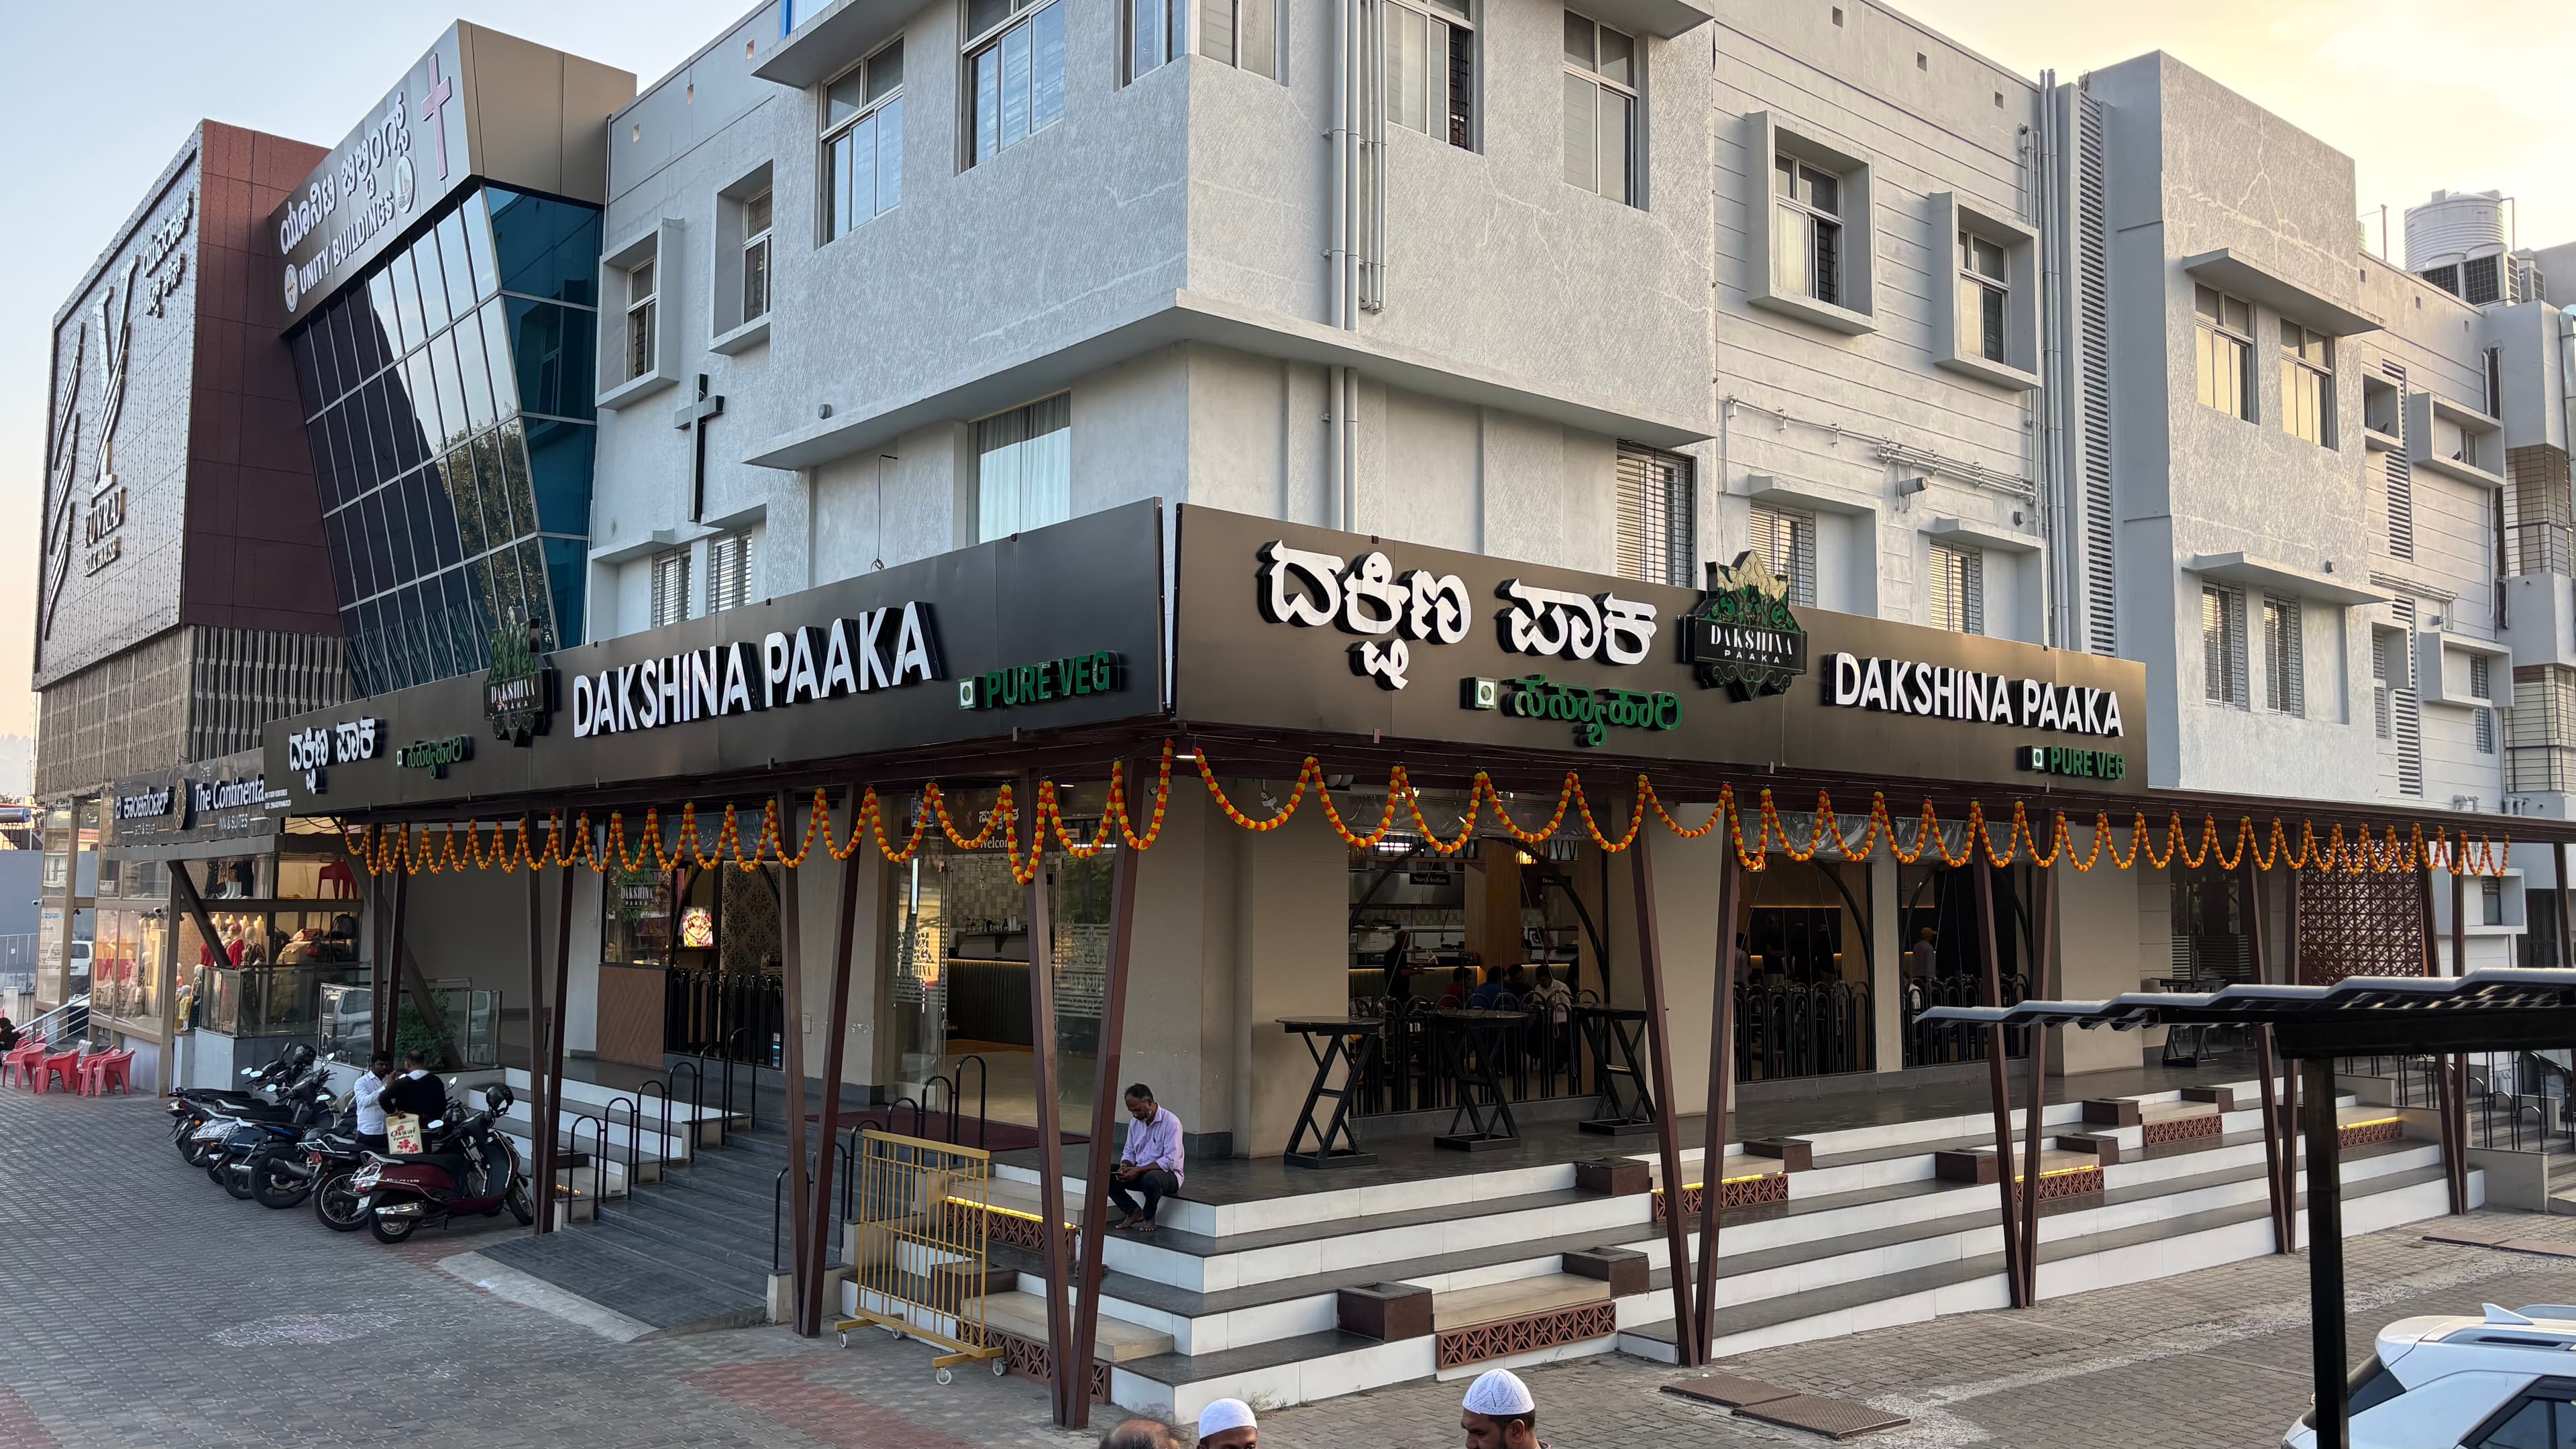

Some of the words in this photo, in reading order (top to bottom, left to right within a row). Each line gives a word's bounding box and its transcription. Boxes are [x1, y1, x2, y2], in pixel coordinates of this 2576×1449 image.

[299, 244, 331, 294] UNITY
[333, 191, 394, 266] BUILDINGS
[85, 488, 125, 548] YUVRAJ
[97, 539, 117, 570] HOUSE
[1271, 539, 1471, 690] ದಕ್ಷಿಣ
[1509, 578, 1657, 665] ಪಾಕ
[1711, 625, 1793, 656] DAKSHINA
[1724, 649, 1781, 664] PAAKA
[574, 641, 751, 738] DAKSHINA
[764, 601, 932, 708] PAAKA
[986, 664, 1051, 708] PURE
[1059, 651, 1111, 696] VEG
[492, 679, 535, 704] DAKSHINA
[498, 703, 528, 711] PAAKA
[1835, 652, 2013, 724] DAKSHINA
[2023, 678, 2123, 737] PAAKA
[288, 727, 328, 795] ದಕ್ಷಿಣ
[336, 716, 375, 763] ಪಾಕ
[2051, 747, 2093, 777] PURE
[2098, 751, 2126, 780] VEG
[195, 784, 211, 812] The
[213, 774, 265, 810] Continenta
[231, 814, 248, 829] SUITES
[621, 886, 653, 900] DAKSHINA
